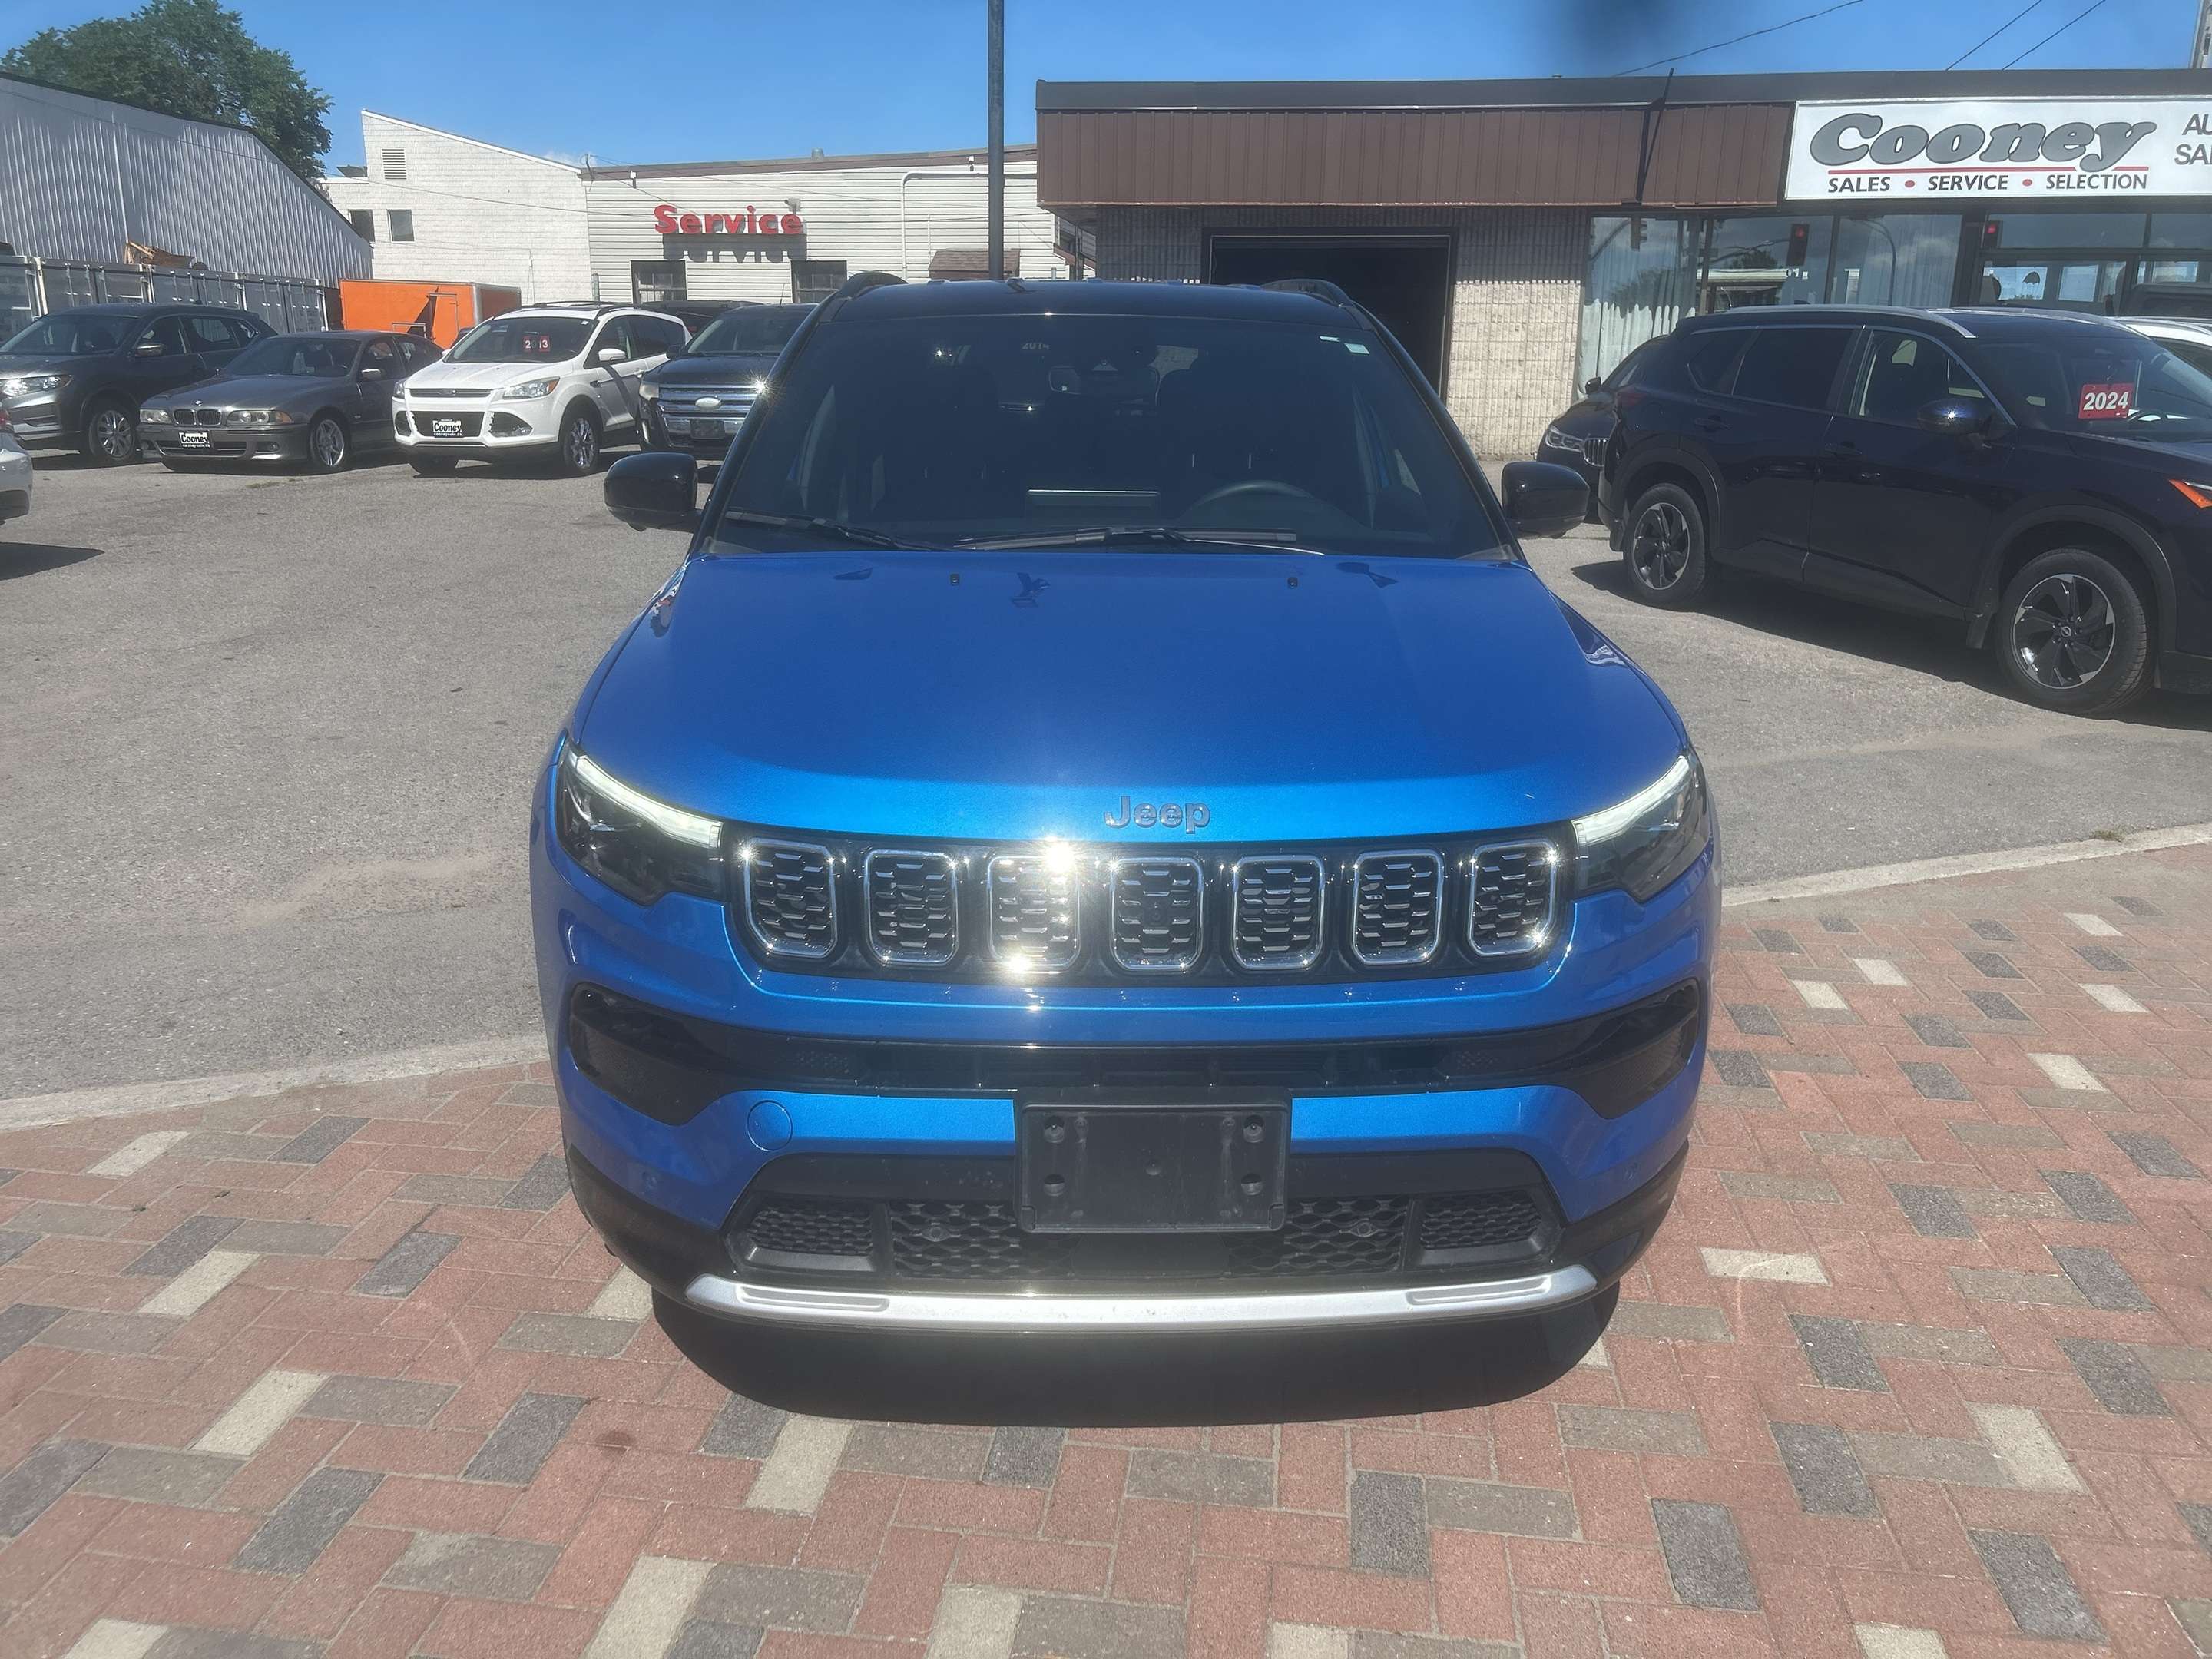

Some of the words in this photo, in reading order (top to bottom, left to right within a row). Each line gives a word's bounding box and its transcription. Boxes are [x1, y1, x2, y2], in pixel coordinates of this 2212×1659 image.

[1810, 113, 2157, 172] Cooney
[2174, 144, 2212, 165] SA
[1828, 177, 1891, 194] SALES
[1928, 174, 2008, 192] SERVICE
[2046, 174, 2147, 190] SELECTION
[654, 204, 804, 234] Service
[2083, 392, 2129, 411] 2024
[434, 422, 462, 433] Cooney
[181, 434, 209, 445] Cooney
[1104, 796, 1210, 834] Jeep
